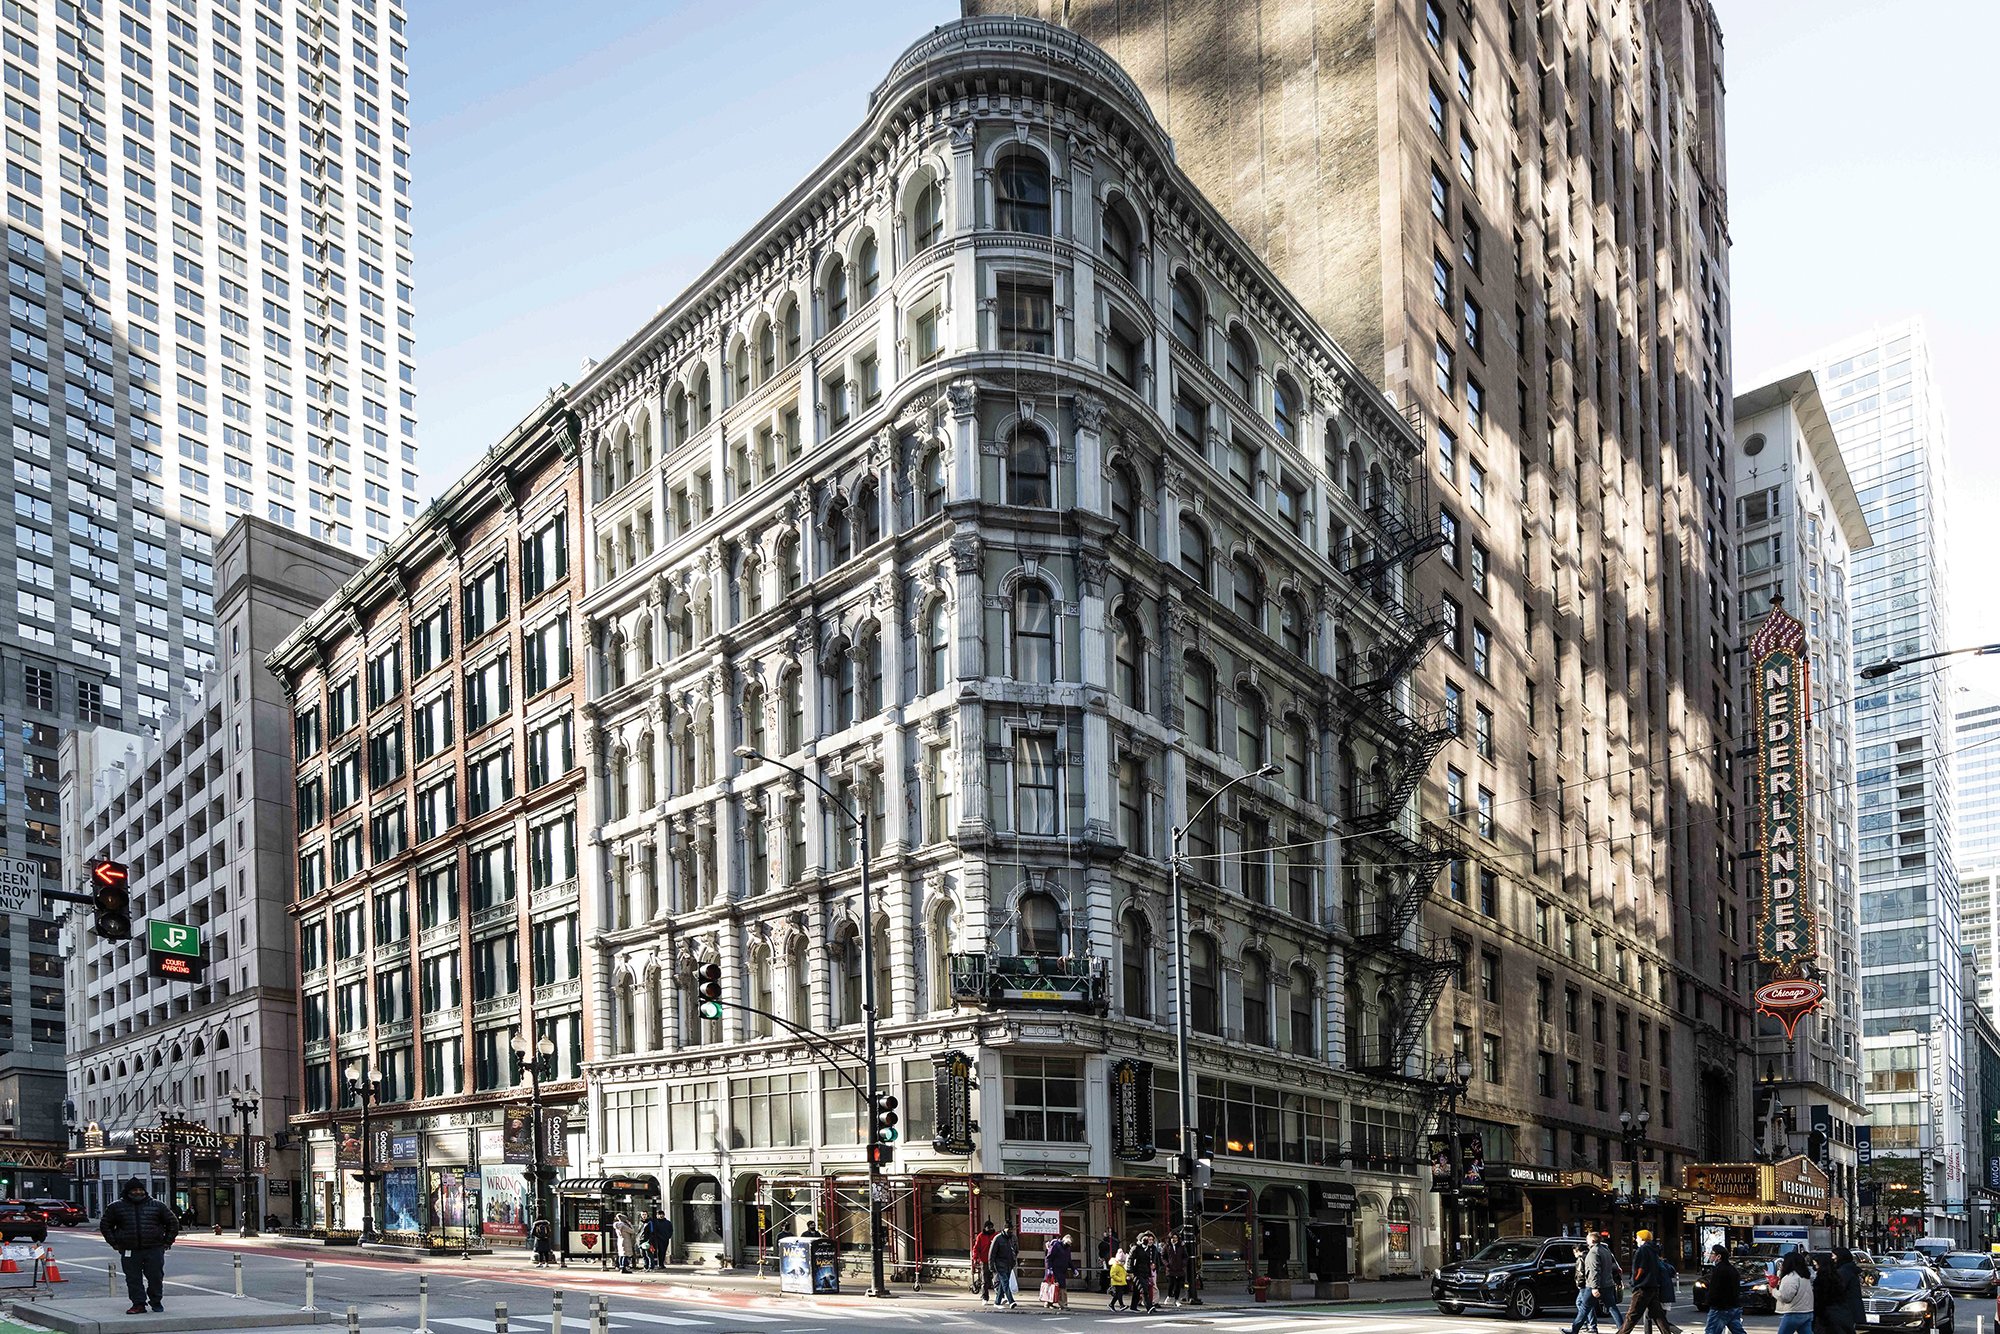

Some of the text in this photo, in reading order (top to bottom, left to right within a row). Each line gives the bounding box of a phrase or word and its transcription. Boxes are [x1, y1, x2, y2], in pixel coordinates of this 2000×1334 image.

[1766, 665, 1797, 952] NEDERLANDER
[16, 862, 35, 875] ON
[0, 872, 29, 887] EEN
[0, 885, 31, 899] ROW
[162, 964, 190, 973] PARKING
[165, 958, 186, 967] COURT
[1771, 989, 1805, 999] Chicago
[1932, 1035, 1944, 1154] JOFFREY BALLET
[186, 1134, 223, 1148] PARK
[553, 1116, 562, 1157] GOODMAN
[258, 1140, 266, 1168] GOODMAN
[380, 1131, 388, 1163] GOODMAN
[1858, 1141, 1870, 1162] OLD
[486, 1175, 521, 1195] WRONG
[1709, 1173, 1753, 1184] PARADISE
[1782, 1180, 1825, 1199] NEDERLANDER
[1022, 1216, 1058, 1225] DESIGNED
